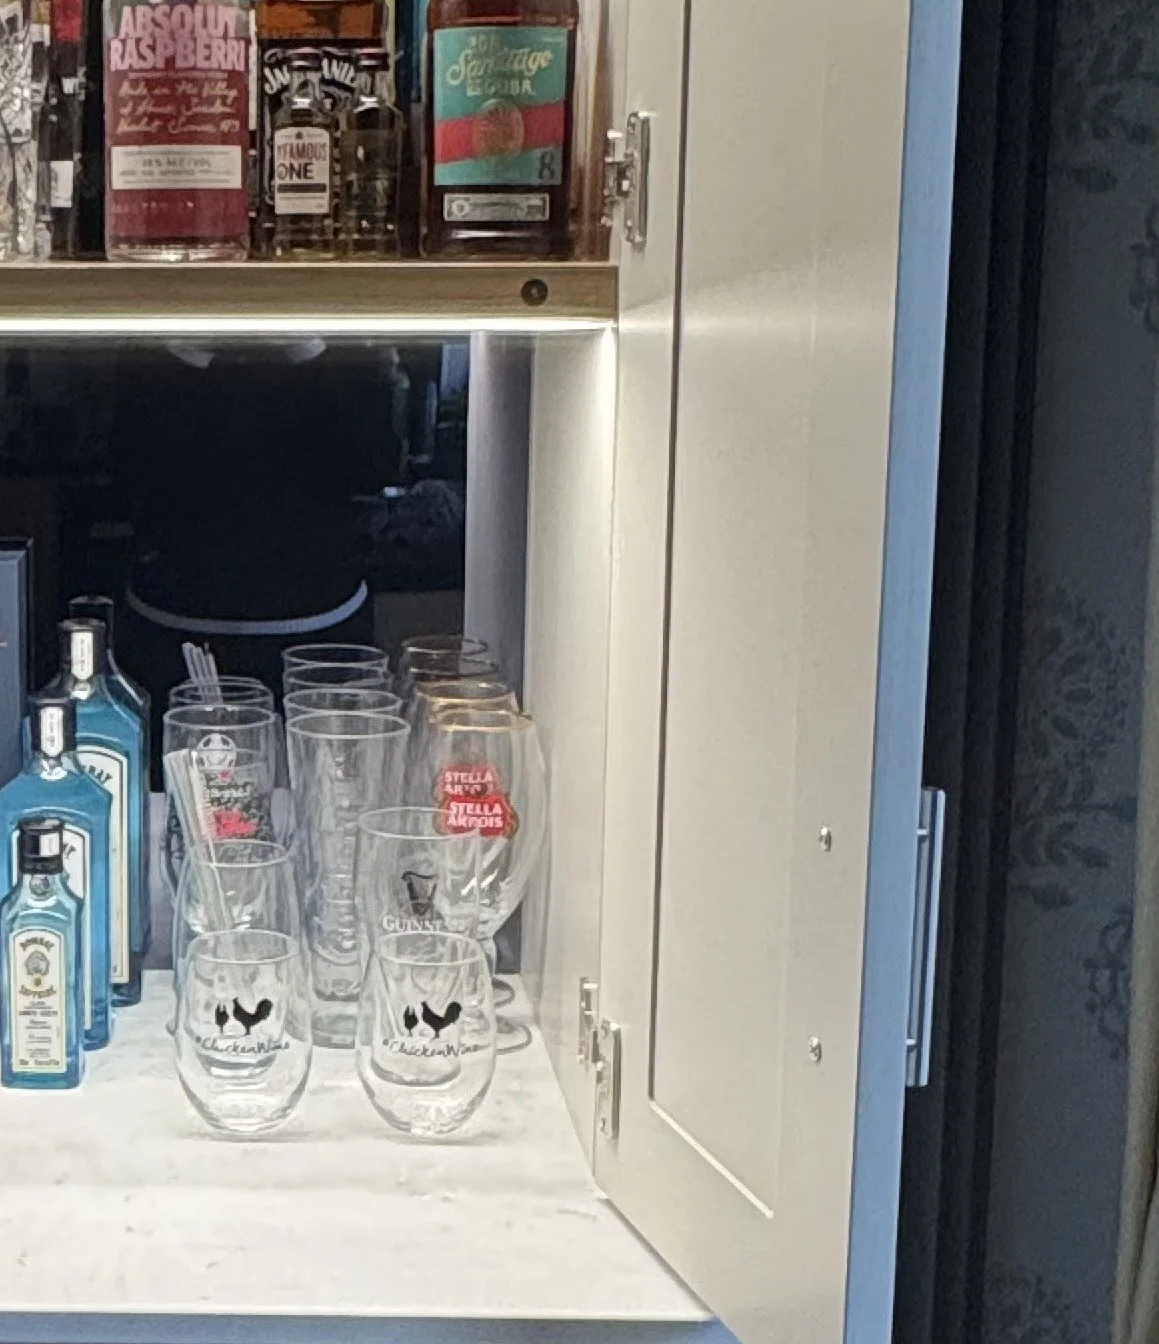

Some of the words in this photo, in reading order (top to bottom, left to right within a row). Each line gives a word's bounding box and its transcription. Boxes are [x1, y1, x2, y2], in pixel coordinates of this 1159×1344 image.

[119, 5, 237, 38] ABSOLUT
[110, 38, 246, 72] RASPBERRI
[277, 162, 314, 180] ONE
[449, 801, 503, 816] STELLA
